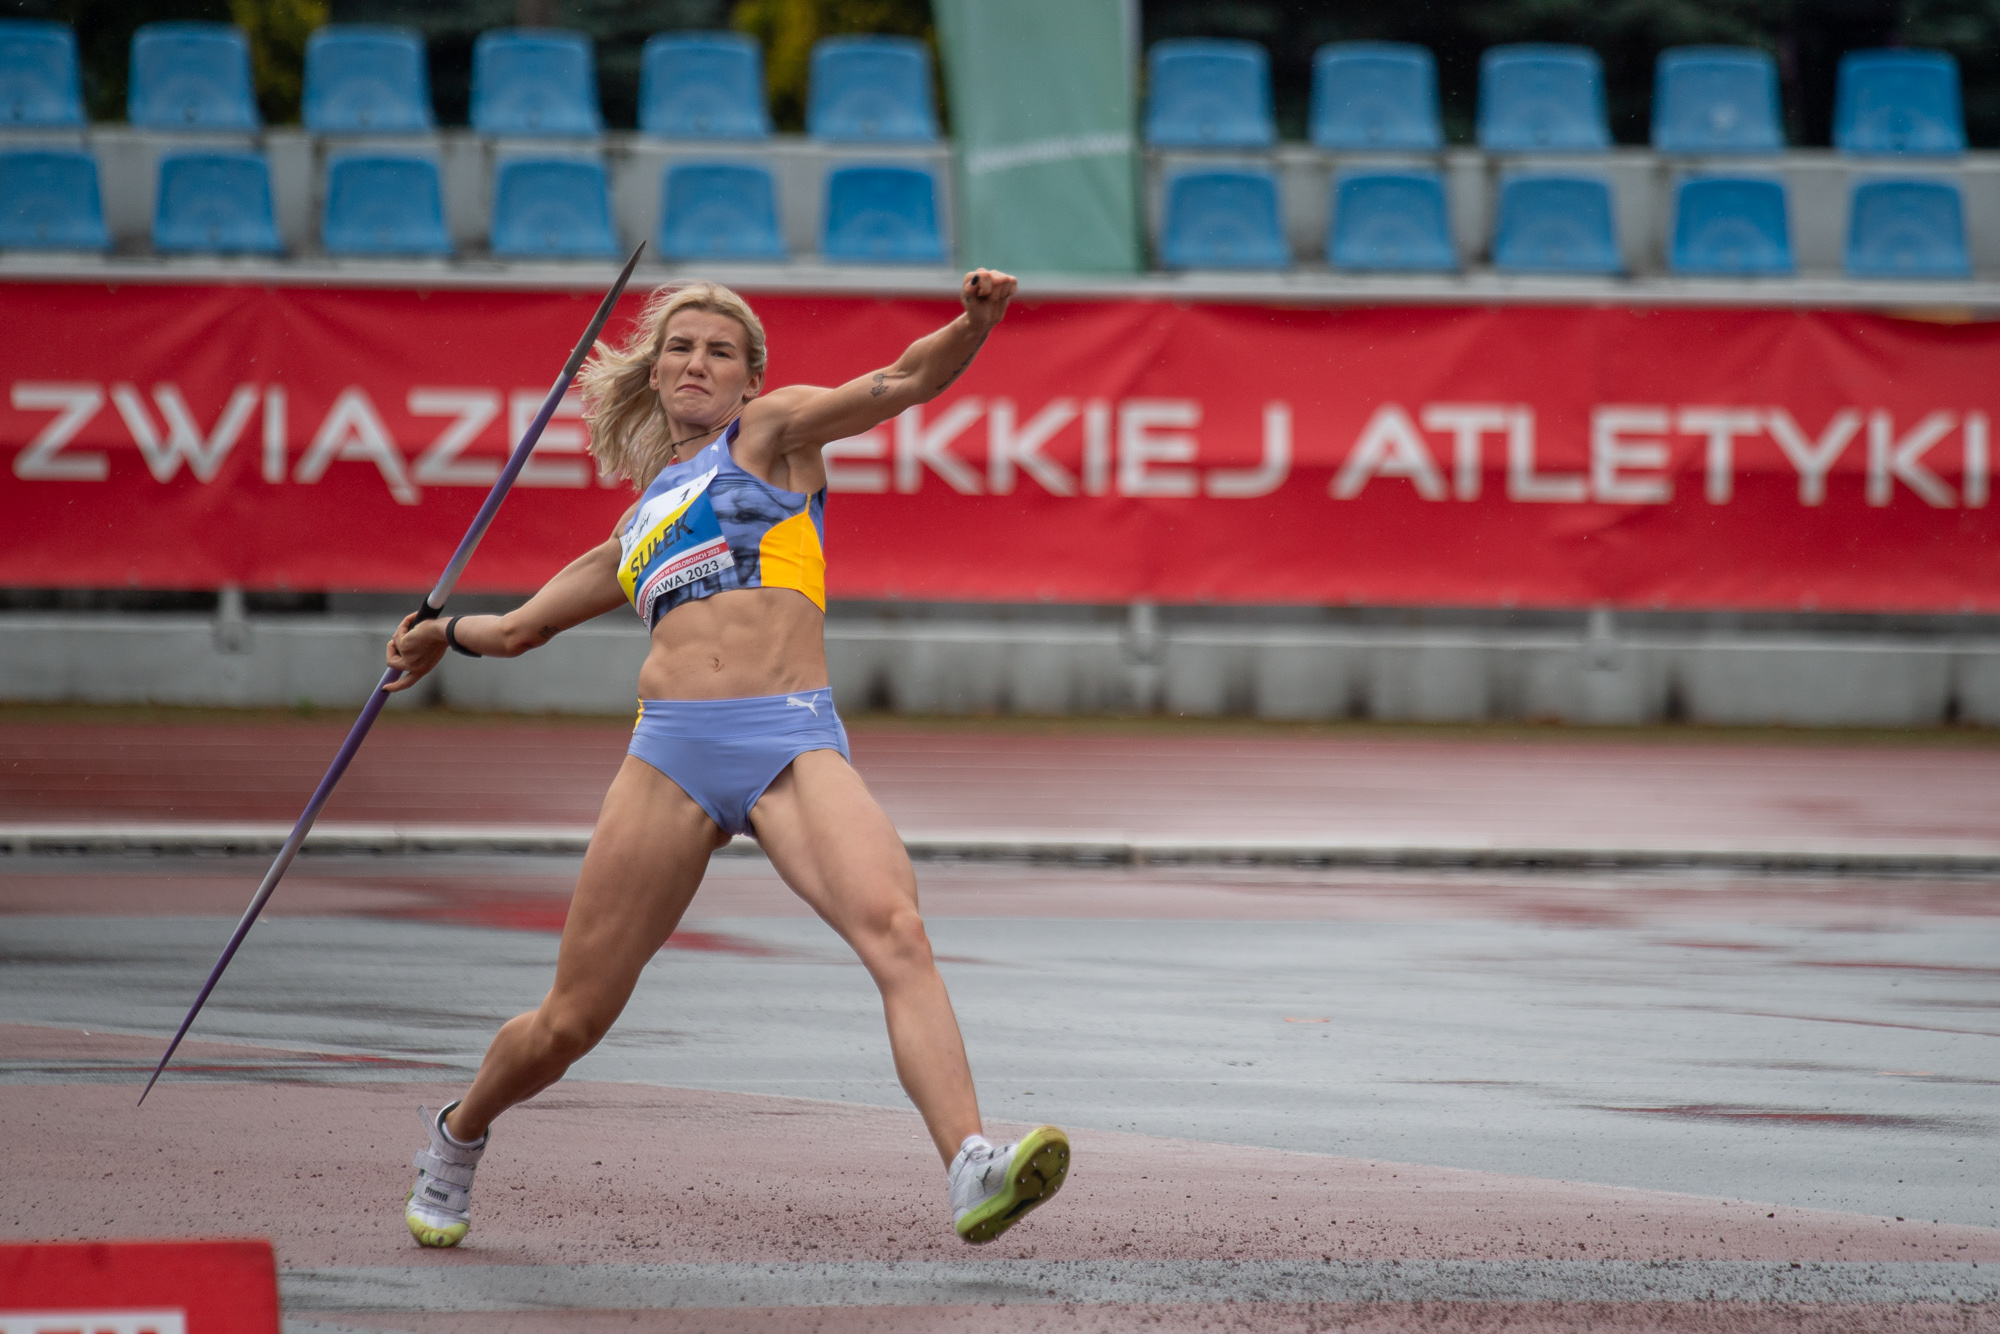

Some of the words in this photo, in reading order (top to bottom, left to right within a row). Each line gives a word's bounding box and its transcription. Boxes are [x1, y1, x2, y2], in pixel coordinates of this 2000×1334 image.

[11, 383, 620, 504] ZWIĄZE
[821, 398, 1294, 500] EKKIEJ
[1331, 403, 1990, 508] ATLETYKI
[630, 510, 694, 583] SUŁEK
[707, 547, 720, 557] 2023
[685, 560, 719, 582] 2023
